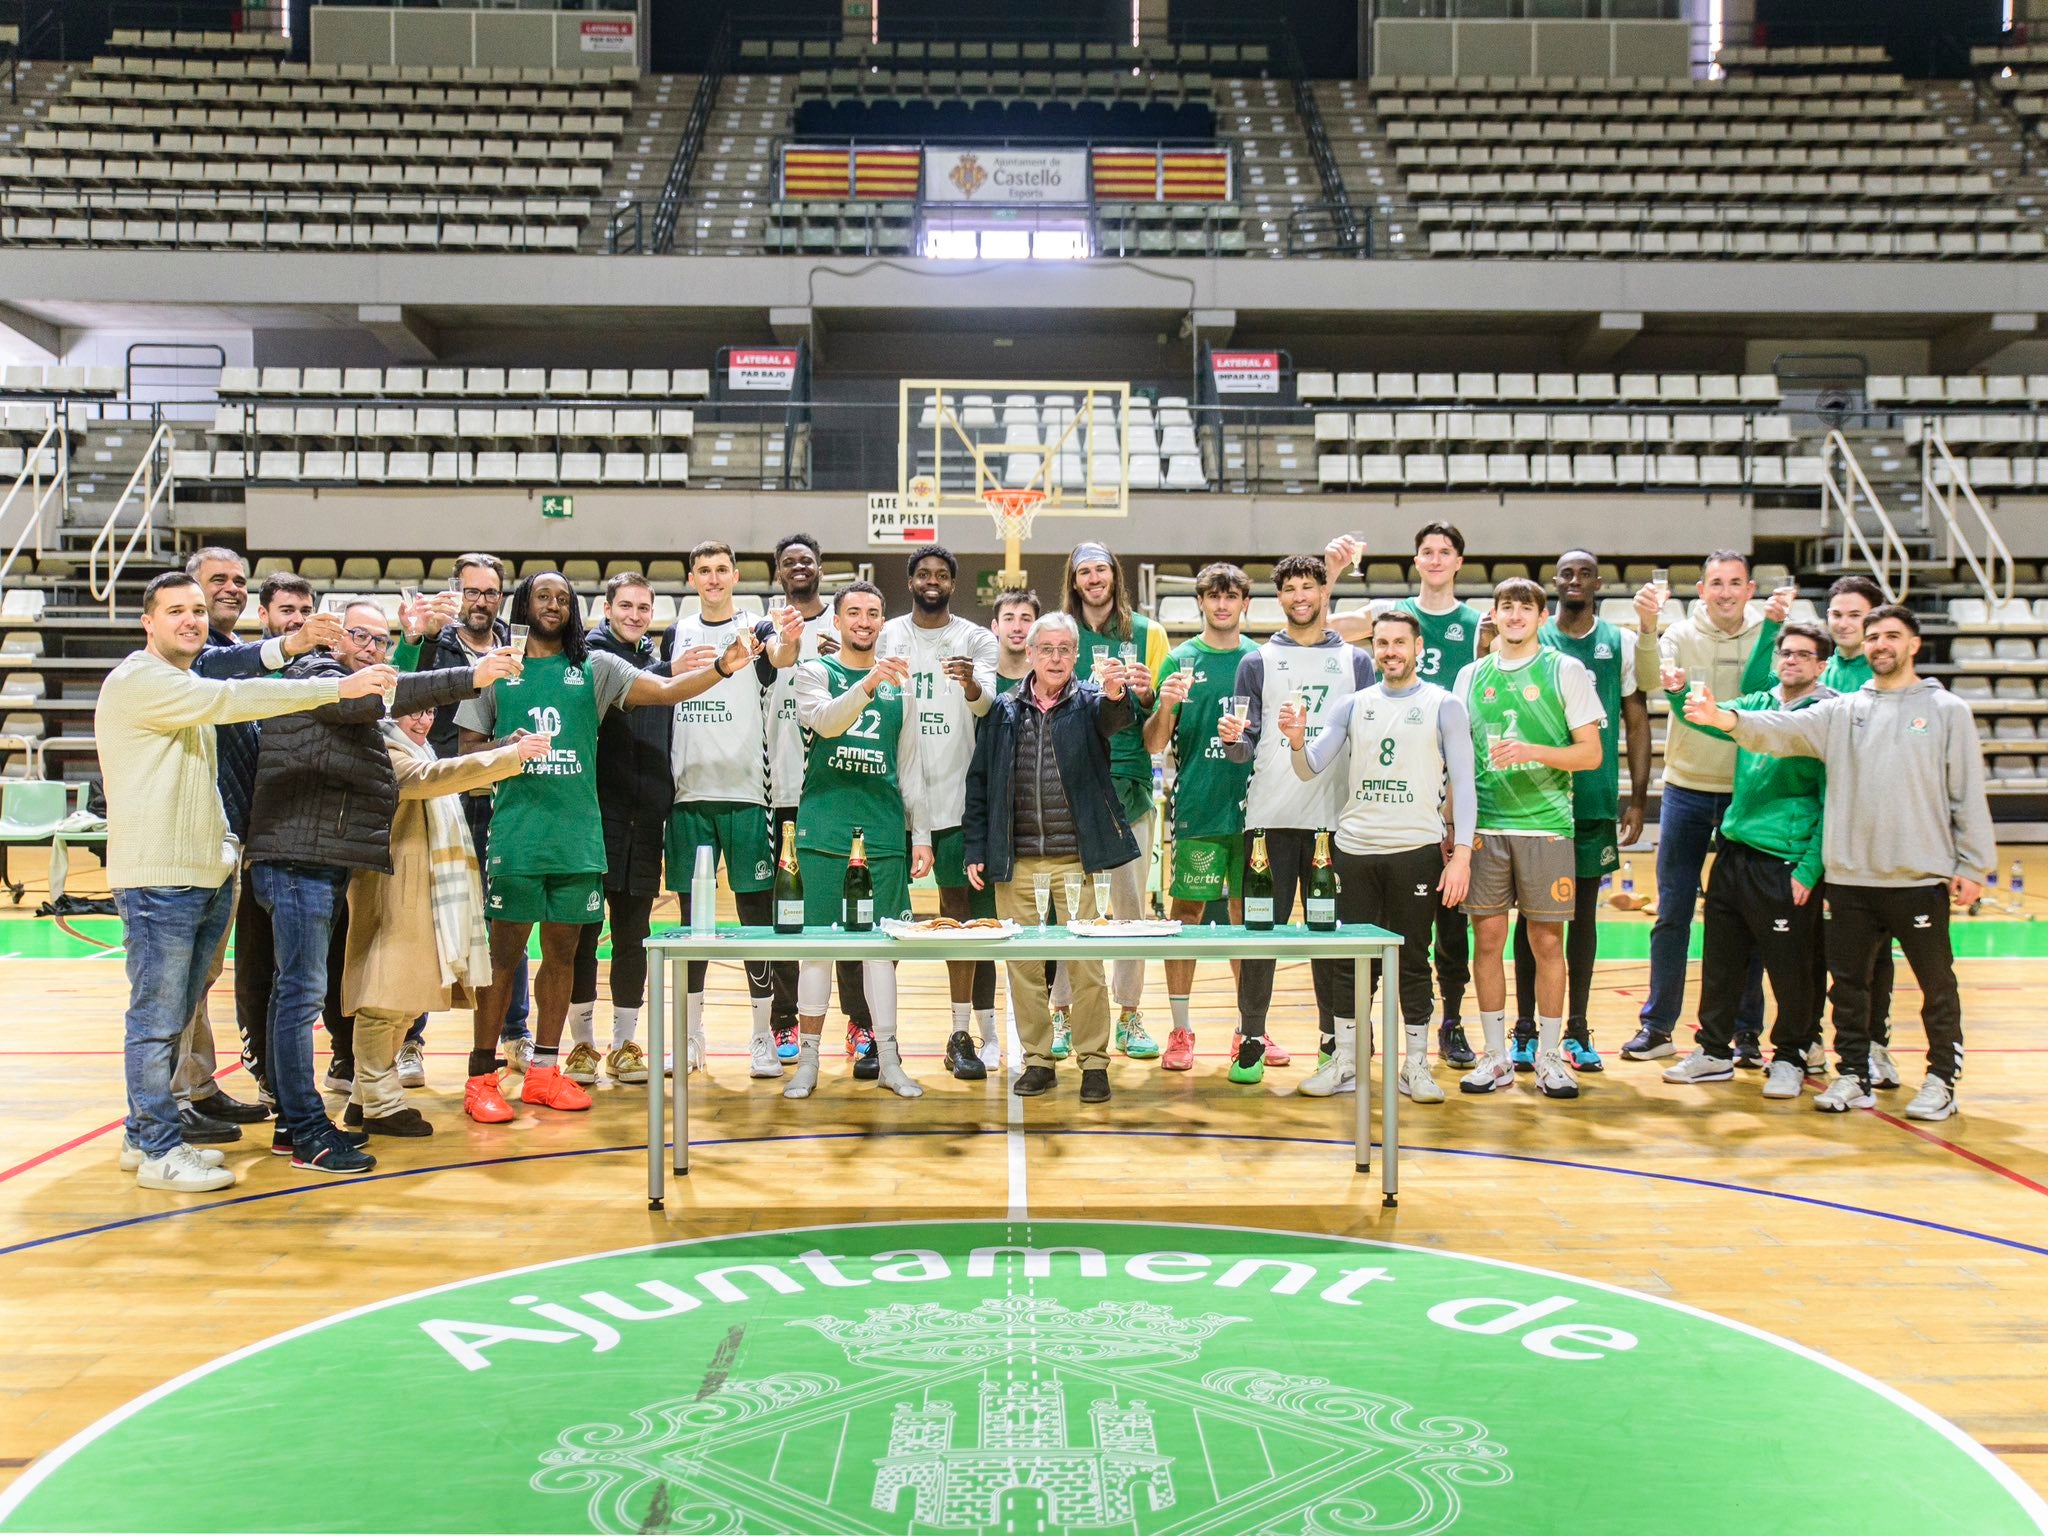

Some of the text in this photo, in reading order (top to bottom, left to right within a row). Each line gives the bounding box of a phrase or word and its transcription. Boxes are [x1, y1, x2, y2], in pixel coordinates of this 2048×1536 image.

[993, 158, 1060, 168] Ajuntament de
[993, 169, 1061, 187] Castelló
[1008, 188, 1043, 199] Esports
[736, 355, 791, 364] LATERAL A
[1216, 358, 1272, 368] LATERAL A
[872, 514, 934, 525] PAR PISTA
[912, 672, 933, 699] 11
[682, 700, 725, 711] AMICS
[528, 706, 561, 737] 10
[677, 710, 733, 722] CASTELLÓ
[920, 712, 944, 724] ICS
[846, 709, 881, 740] 22
[921, 723, 950, 735] ELLÓ
[1502, 709, 1518, 738] 2
[836, 746, 884, 763] AMICS
[1379, 737, 1396, 766] 8
[828, 756, 887, 774] CASTELLÓ
[1362, 780, 1408, 791] AMICS
[1183, 872, 1220, 884] ibertic
[418, 1246, 1638, 1372] Ajuntament de
